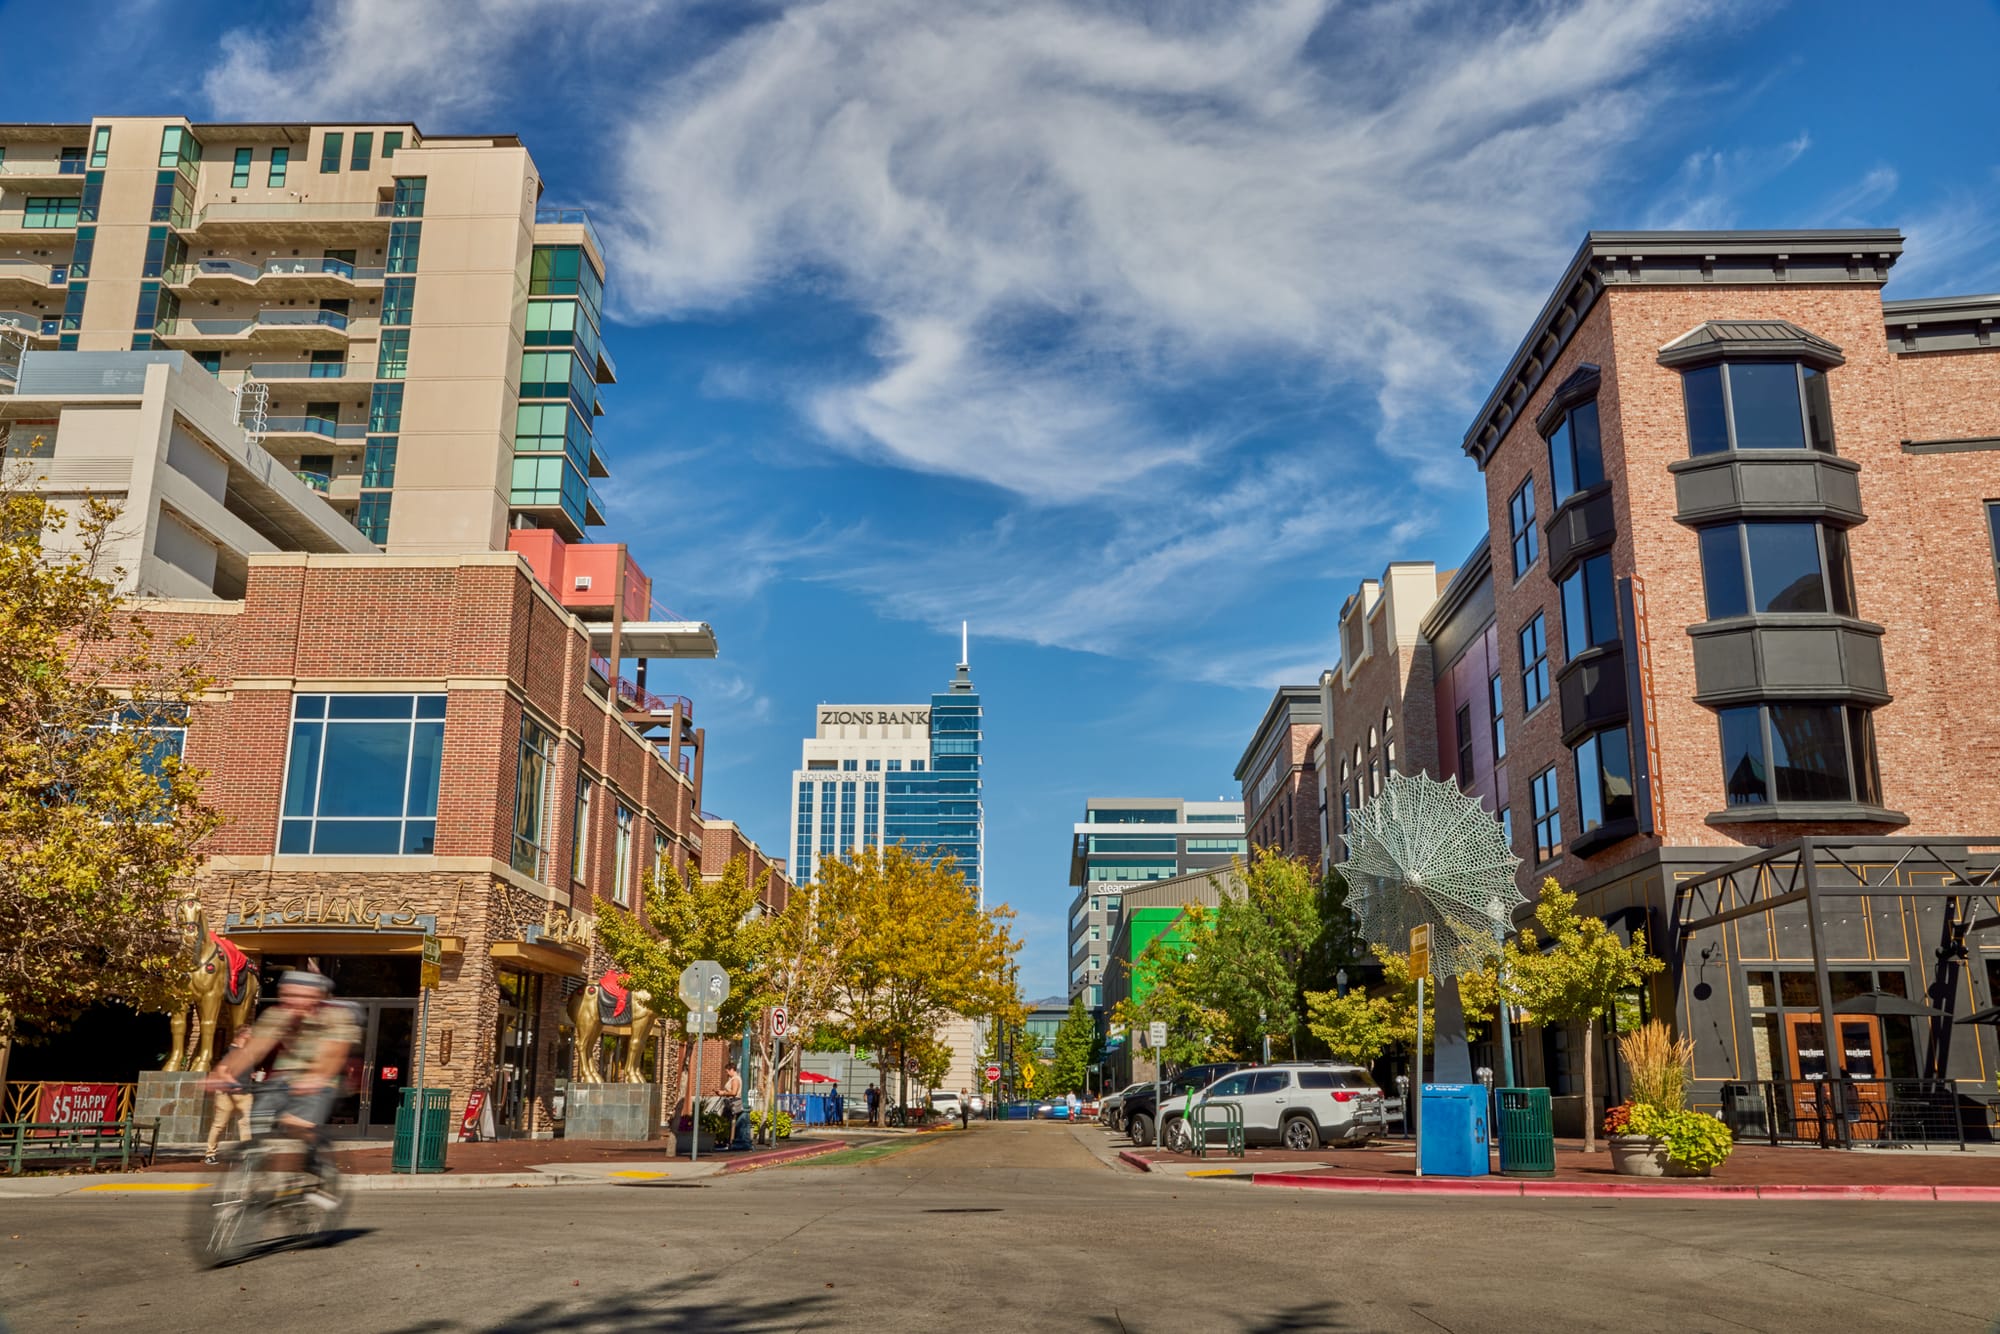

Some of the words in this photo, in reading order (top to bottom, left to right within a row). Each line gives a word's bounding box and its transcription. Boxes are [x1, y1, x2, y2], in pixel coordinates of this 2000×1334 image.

[1633, 579, 1643, 592] THE
[820, 711, 873, 725] ZIONS
[877, 711, 930, 725] BANK
[1636, 591, 1663, 831] WAREHOUSE
[800, 773, 842, 781] HOLLAND
[844, 773, 852, 781] &
[854, 773, 878, 781] HART
[282, 892, 417, 931] CHANGS
[73, 1095, 107, 1109] HAPPY
[50, 1096, 71, 1123] $5
[72, 1110, 104, 1123] HOUR
